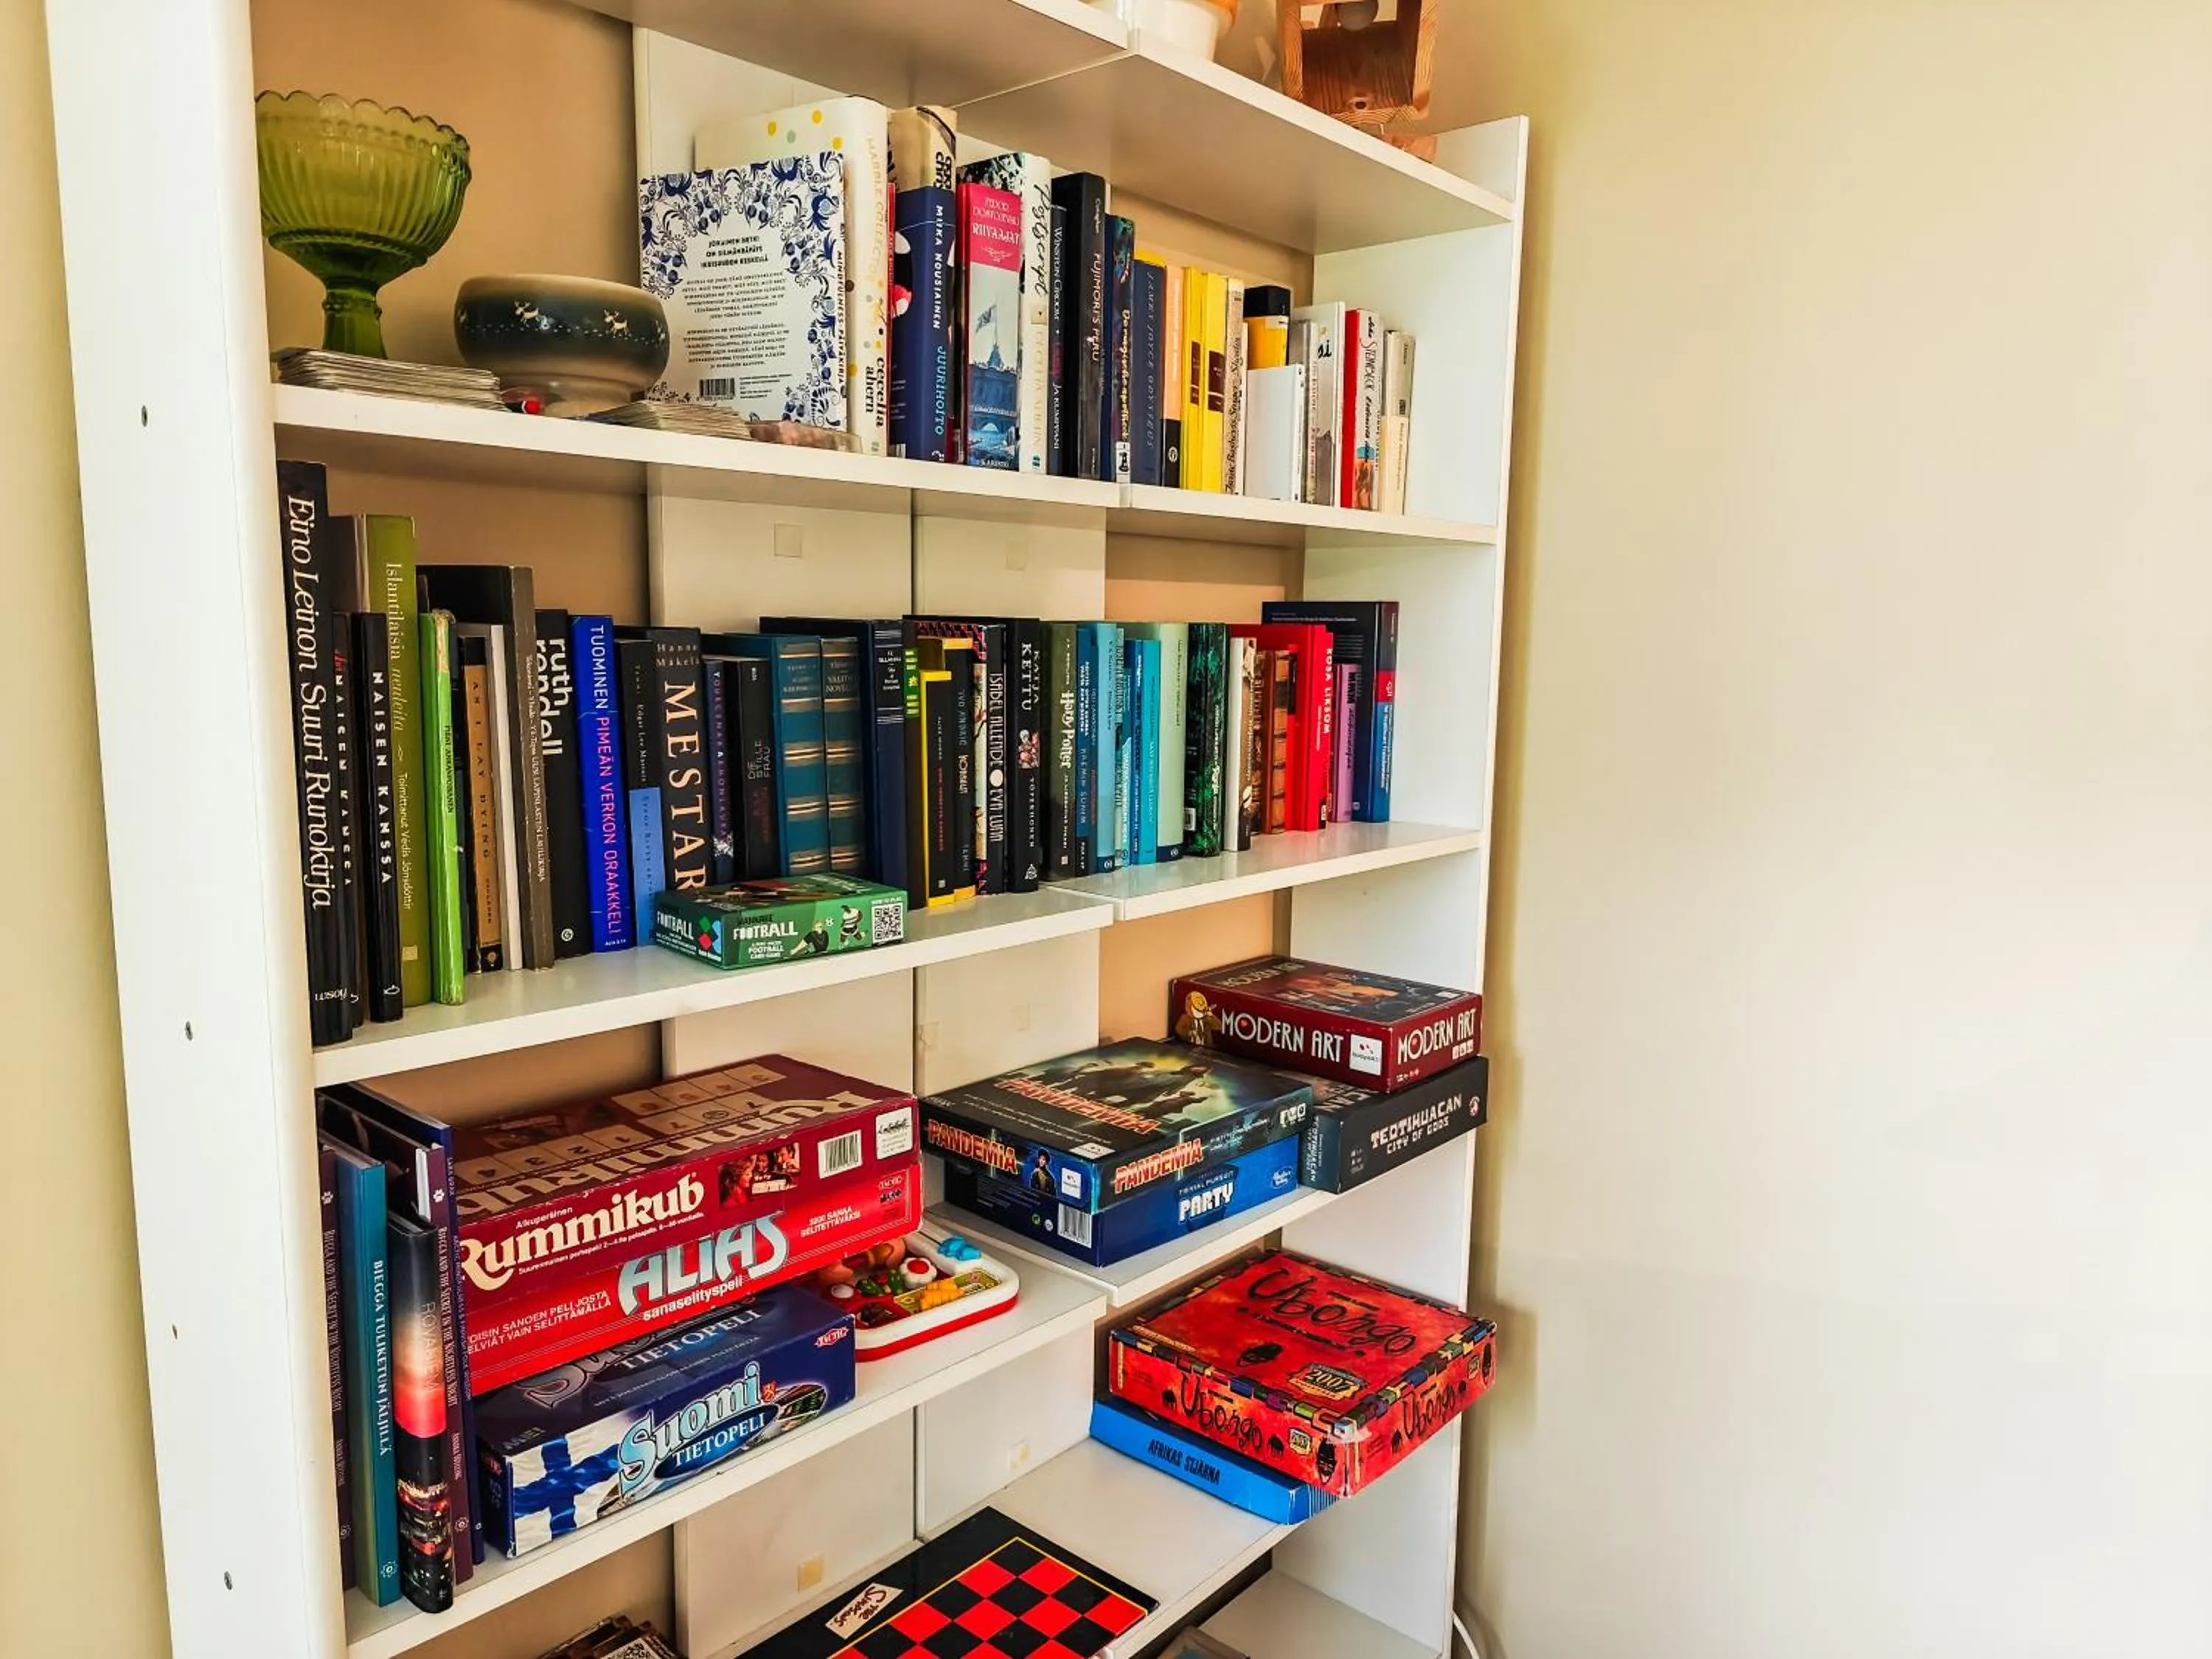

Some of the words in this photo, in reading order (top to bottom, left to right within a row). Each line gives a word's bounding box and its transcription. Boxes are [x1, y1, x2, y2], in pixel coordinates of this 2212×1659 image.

[935, 205, 945, 246] MIIKA
[1031, 184, 1051, 296] Postscript
[1053, 226, 1062, 277] WINSTON
[933, 253, 944, 330] NOUSIAINEN
[1092, 252, 1102, 324] FUJIMORI'S
[865, 366, 875, 413] ahern
[875, 357, 886, 428] cecelia
[935, 346, 946, 436] JUURIHOITO
[288, 495, 315, 565] Eino
[293, 571, 319, 672] Leinon
[386, 563, 405, 661] Islantilaisia
[549, 638, 573, 706] ruth
[590, 625, 608, 709] TUOMINEN
[989, 672, 1004, 712] ISABEL
[1021, 642, 1032, 711] KETTU
[299, 682, 327, 763] Suuri
[372, 672, 387, 768] NAISEN
[390, 667, 407, 731] neuleita
[536, 639, 563, 755] rendell
[1060, 691, 1075, 728] Harry
[1324, 687, 1333, 734] LIKSOM
[596, 717, 613, 777] PIMEÄN
[754, 740, 763, 779] STILLE
[762, 745, 771, 779] FRAU
[988, 715, 1004, 767] ALLENDE
[1060, 728, 1075, 769] Potter
[473, 681, 479, 704] AS
[480, 793, 489, 858] DYING
[746, 761, 757, 780] DIE
[399, 773, 410, 832] Toimittanut
[600, 782, 617, 844] VERKON
[990, 788, 1004, 810] EVA
[304, 771, 335, 909] Runokirja
[377, 785, 393, 885] KANSSA
[990, 815, 1005, 842] LUNA
[604, 849, 622, 934] ORAAKKELI
[655, 911, 695, 941] FOOTBALL
[732, 920, 799, 941] FOOTBALL
[748, 945, 785, 955] FOOTBALL
[1220, 1008, 1304, 1053] MODERN
[1311, 1029, 1344, 1063] ART
[1397, 1017, 1454, 1065] MODERN
[1456, 1007, 1478, 1041] ART
[993, 1076, 1162, 1134] PANDEMIA
[1371, 1093, 1463, 1150] TEOTIHUACAN
[927, 1118, 1019, 1175] PANDEMIA
[1386, 1137, 1409, 1155] CITY
[1411, 1130, 1424, 1143] OF
[1426, 1116, 1450, 1135] GODS
[1113, 1138, 1204, 1194] PANDEMIA
[515, 1206, 574, 1229] Alkuperäinen
[1178, 1182, 1235, 1222] PARTY
[460, 1175, 705, 1291] Rummikub
[326, 1258, 335, 1274] AND
[327, 1275, 337, 1290] THE
[373, 1259, 385, 1312] BIEGGA
[439, 1256, 448, 1271] AND
[440, 1272, 450, 1287] THE
[327, 1291, 339, 1320] SECRET
[440, 1287, 452, 1316] SECRET
[467, 1326, 501, 1344] OISIN
[502, 1311, 548, 1333] SANOEN
[549, 1303, 574, 1318] PELI
[571, 1290, 609, 1310] JOSTA
[507, 1327, 532, 1341] VAIN
[532, 1299, 612, 1332] SELITTÄMÄLLÄ
[642, 1276, 744, 1323] sanaselityspeli
[1248, 1267, 1418, 1354] Ubongo
[375, 1314, 389, 1394] TULIKETUN
[613, 1308, 763, 1371] TIETOPELI
[332, 1388, 342, 1412] NIGHT
[447, 1381, 458, 1407] NIGHT
[1304, 1367, 1355, 1394] 2007
[376, 1397, 392, 1456] JÄLJILLÄ
[618, 1360, 762, 1496] Suomi
[1179, 1370, 1264, 1452] Ubongo
[1402, 1386, 1455, 1439] Ubongo
[671, 1413, 767, 1467] TIETOPELI
[1147, 1438, 1183, 1471] AFRIKAS
